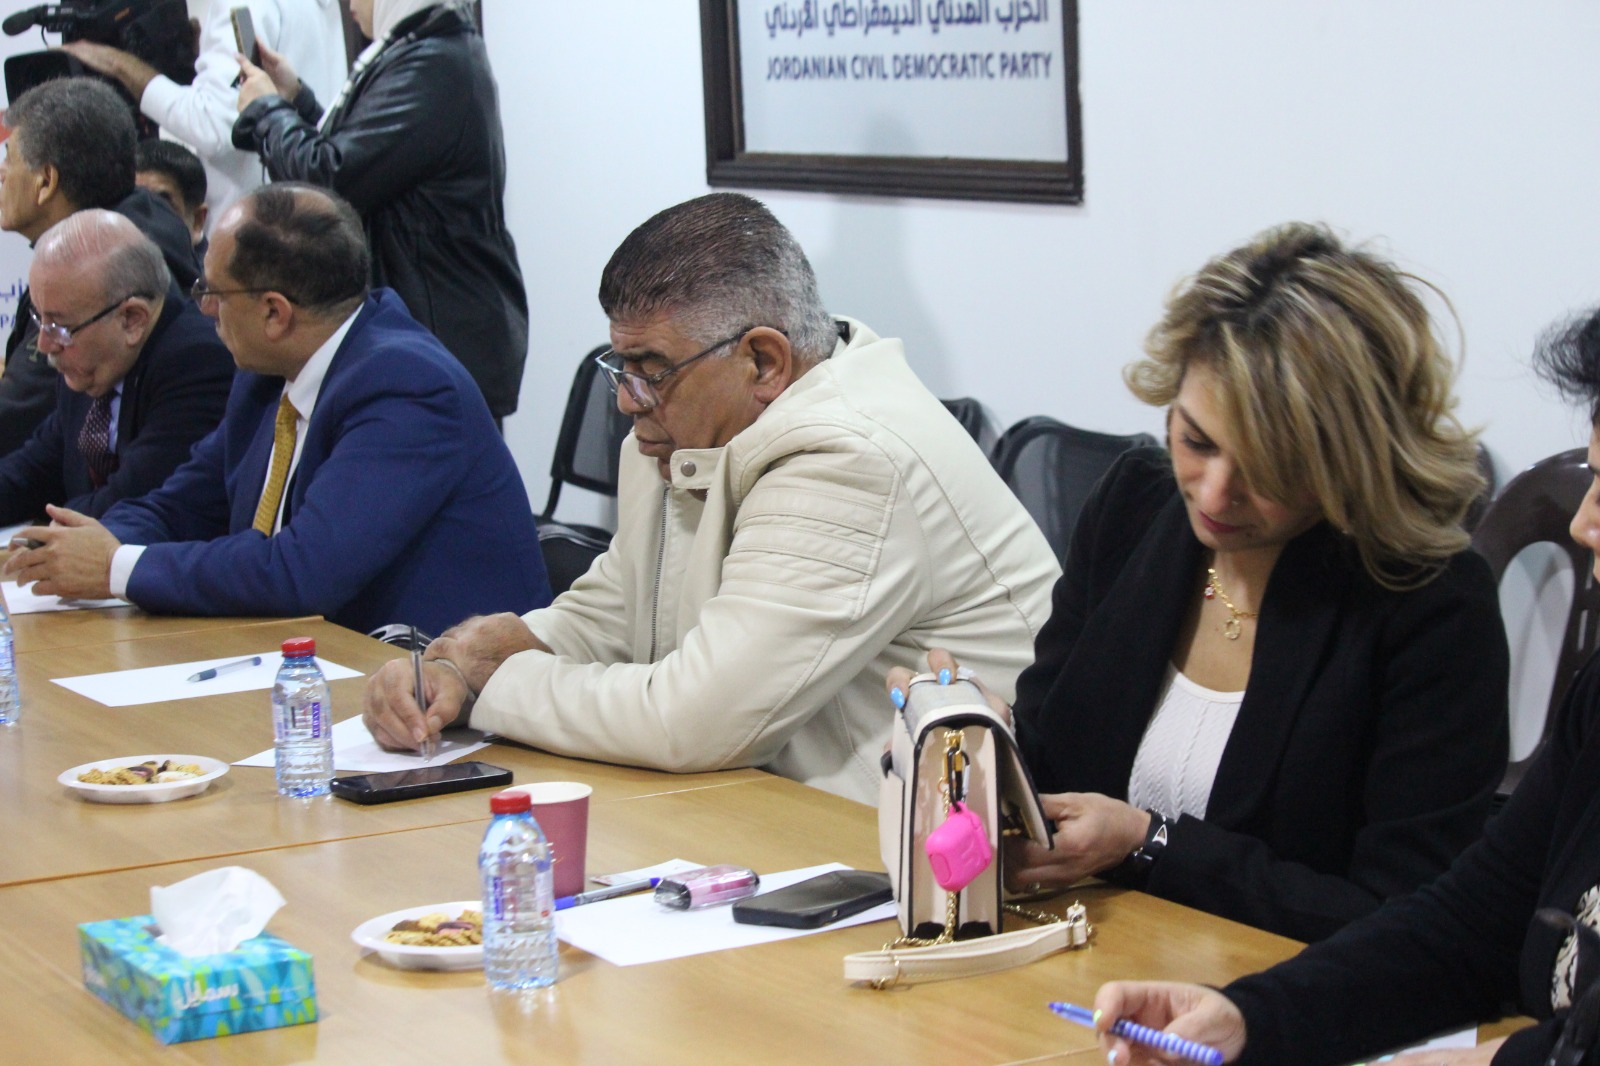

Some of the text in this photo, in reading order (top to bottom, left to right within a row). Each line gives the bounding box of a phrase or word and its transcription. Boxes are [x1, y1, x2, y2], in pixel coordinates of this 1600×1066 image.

[822, 0, 921, 36] الديمقراطي
[927, 0, 989, 34] المدني
[995, 0, 1048, 32] الحزب
[766, 52, 1052, 81] JORDANIAN CIVIL DEMOCRATIC PARTY
